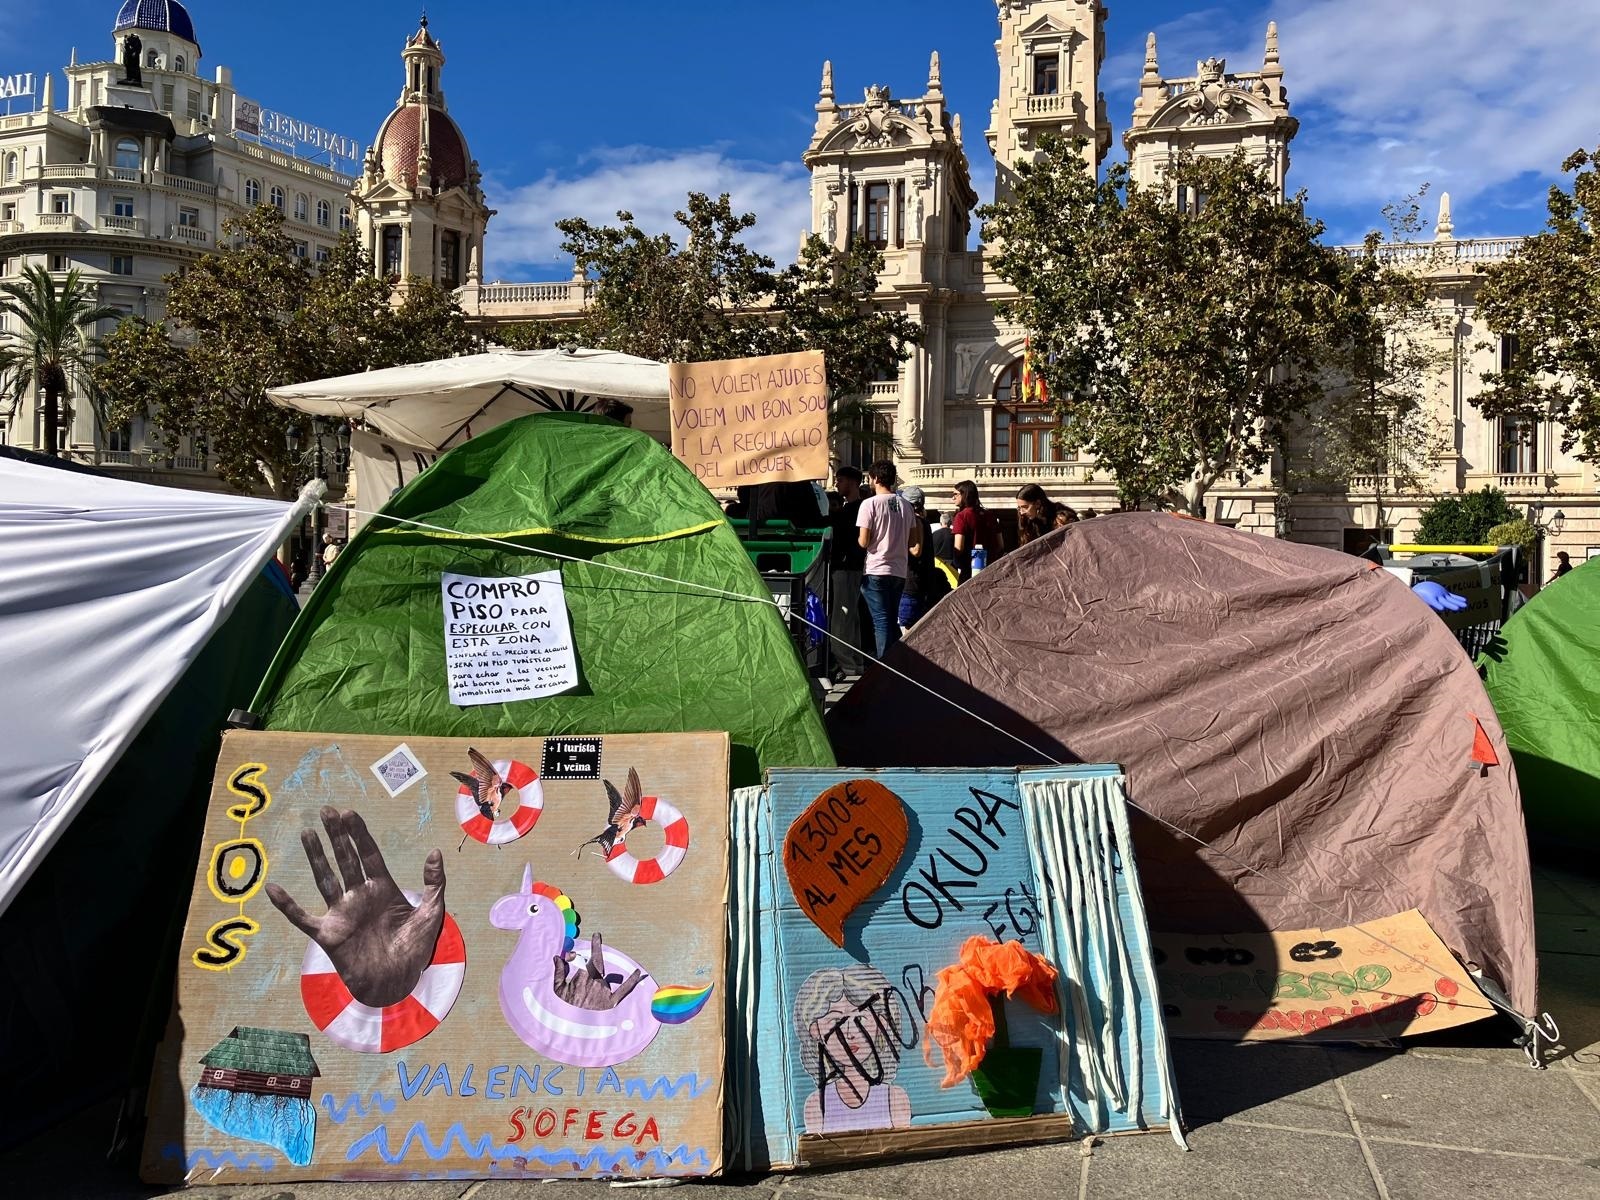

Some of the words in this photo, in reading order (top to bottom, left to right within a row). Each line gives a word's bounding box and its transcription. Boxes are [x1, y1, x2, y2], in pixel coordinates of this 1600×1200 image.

[260, 108, 359, 160] GENERALI
[670, 376, 696, 399] NO
[712, 372, 762, 394] VOLEM
[767, 364, 824, 388] AJUDES
[672, 407, 726, 430] VOLEM
[735, 404, 756, 423] UN
[762, 399, 792, 419] BON
[798, 394, 827, 413] SOU
[680, 437, 687, 457] I
[699, 435, 722, 456] LA
[733, 422, 823, 452] REGULACIÓ
[694, 462, 723, 479] DEL
[735, 455, 794, 476] LLOGUER
[447, 580, 540, 599] COMPRO
[511, 606, 548, 616] PARA
[450, 622, 520, 635] ESPECULAR
[522, 620, 551, 630] CON
[452, 637, 490, 648] ESTA
[496, 634, 541, 645] ZONA
[452, 673, 472, 681] para
[476, 671, 499, 679] echar
[473, 679, 500, 687] barrio
[458, 687, 511, 698] inmobiliaria
[534, 679, 569, 689] cercana
[563, 743, 596, 753] turista
[902, 786, 1020, 930] OKUPA
[803, 884, 837, 916] AL
[827, 826, 882, 886] MES
[397, 1061, 622, 1101] VALENCIA
[506, 1105, 661, 1147] S'OFEGA
